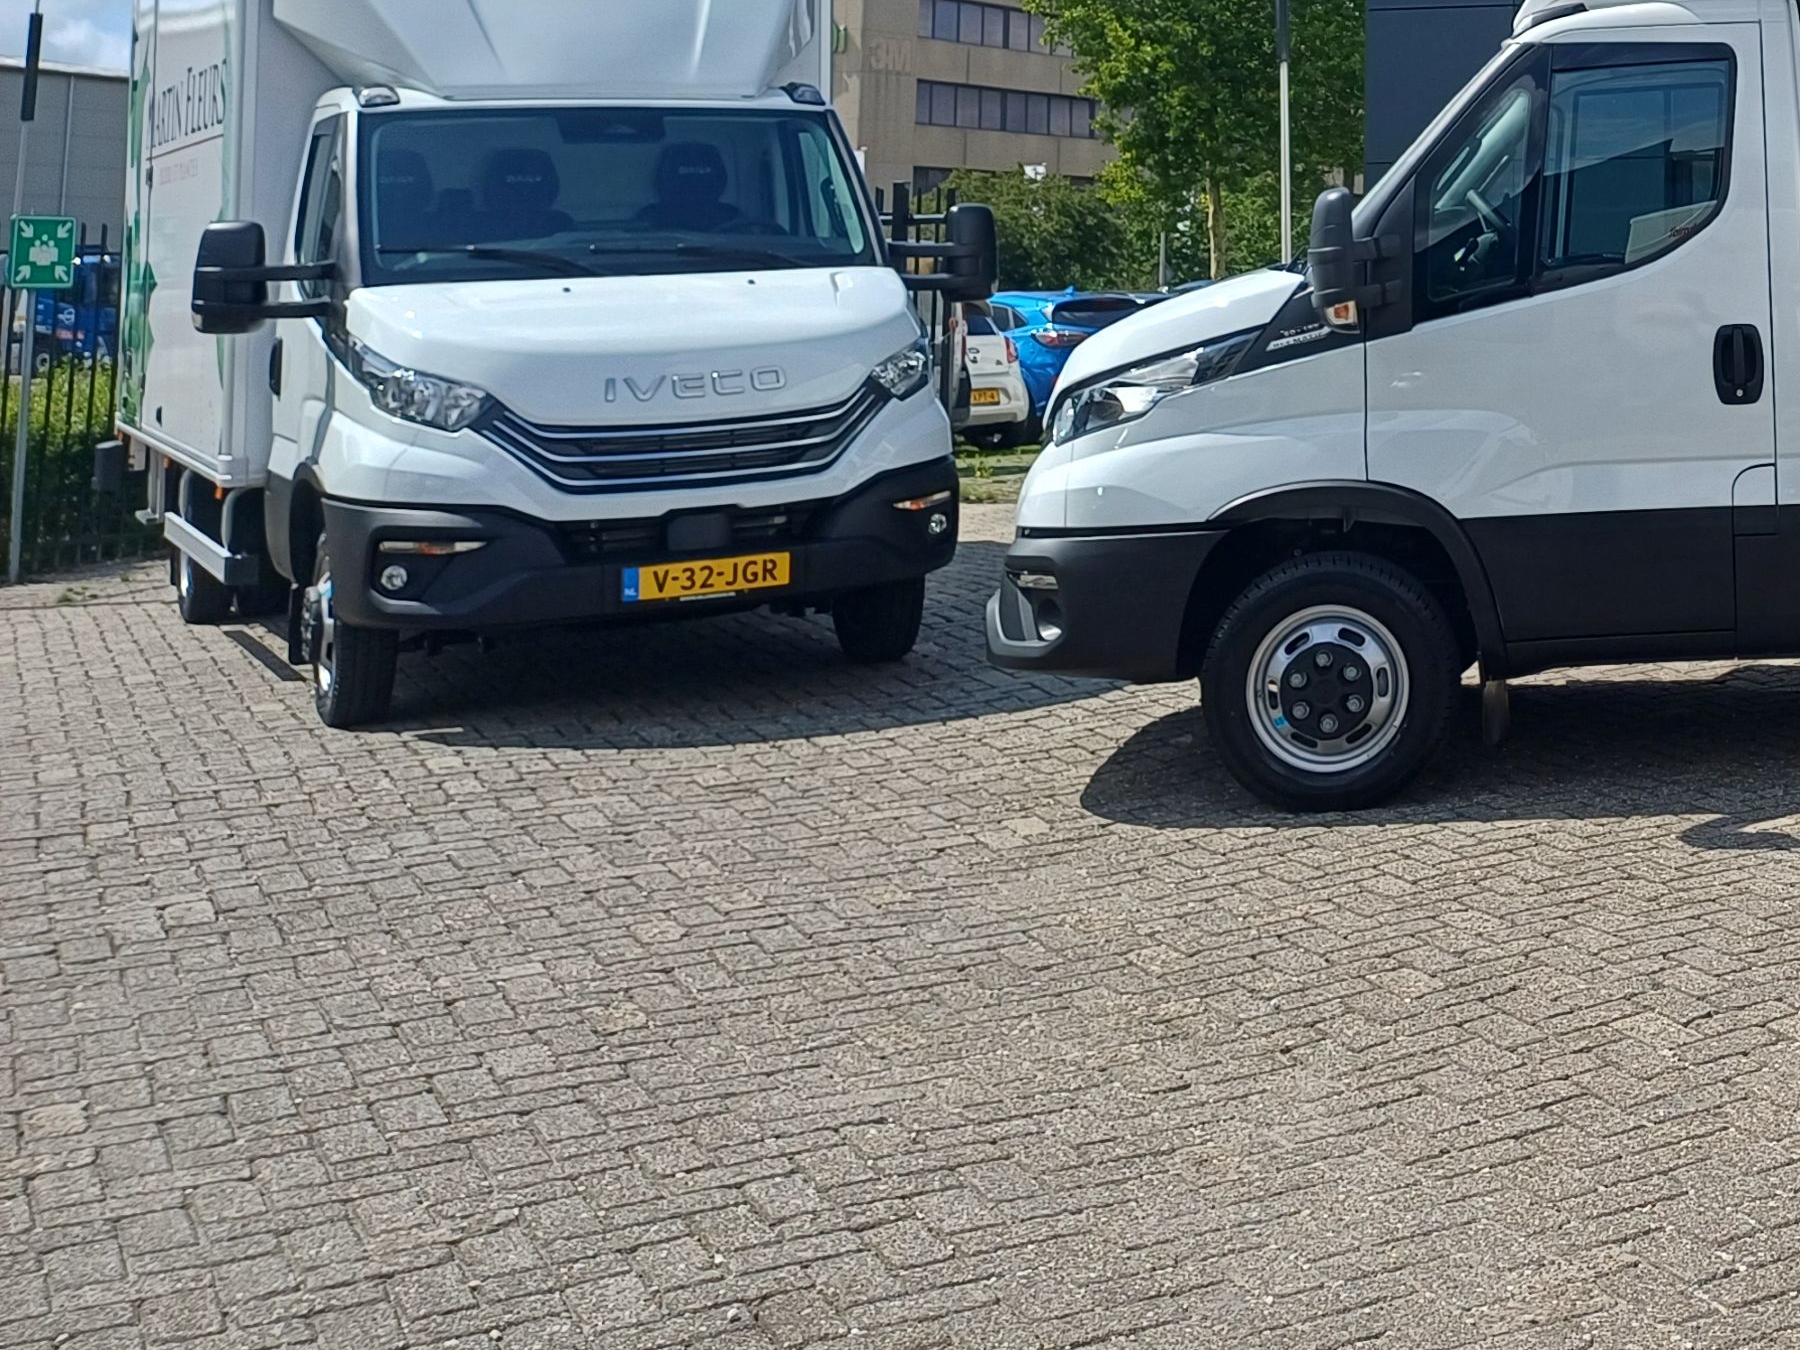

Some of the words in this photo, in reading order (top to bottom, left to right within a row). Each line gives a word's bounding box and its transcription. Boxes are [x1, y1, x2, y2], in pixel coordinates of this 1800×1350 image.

[603, 365, 787, 403] IVECO
[623, 586, 637, 596] NL
[652, 558, 778, 593] V-32-JGR
